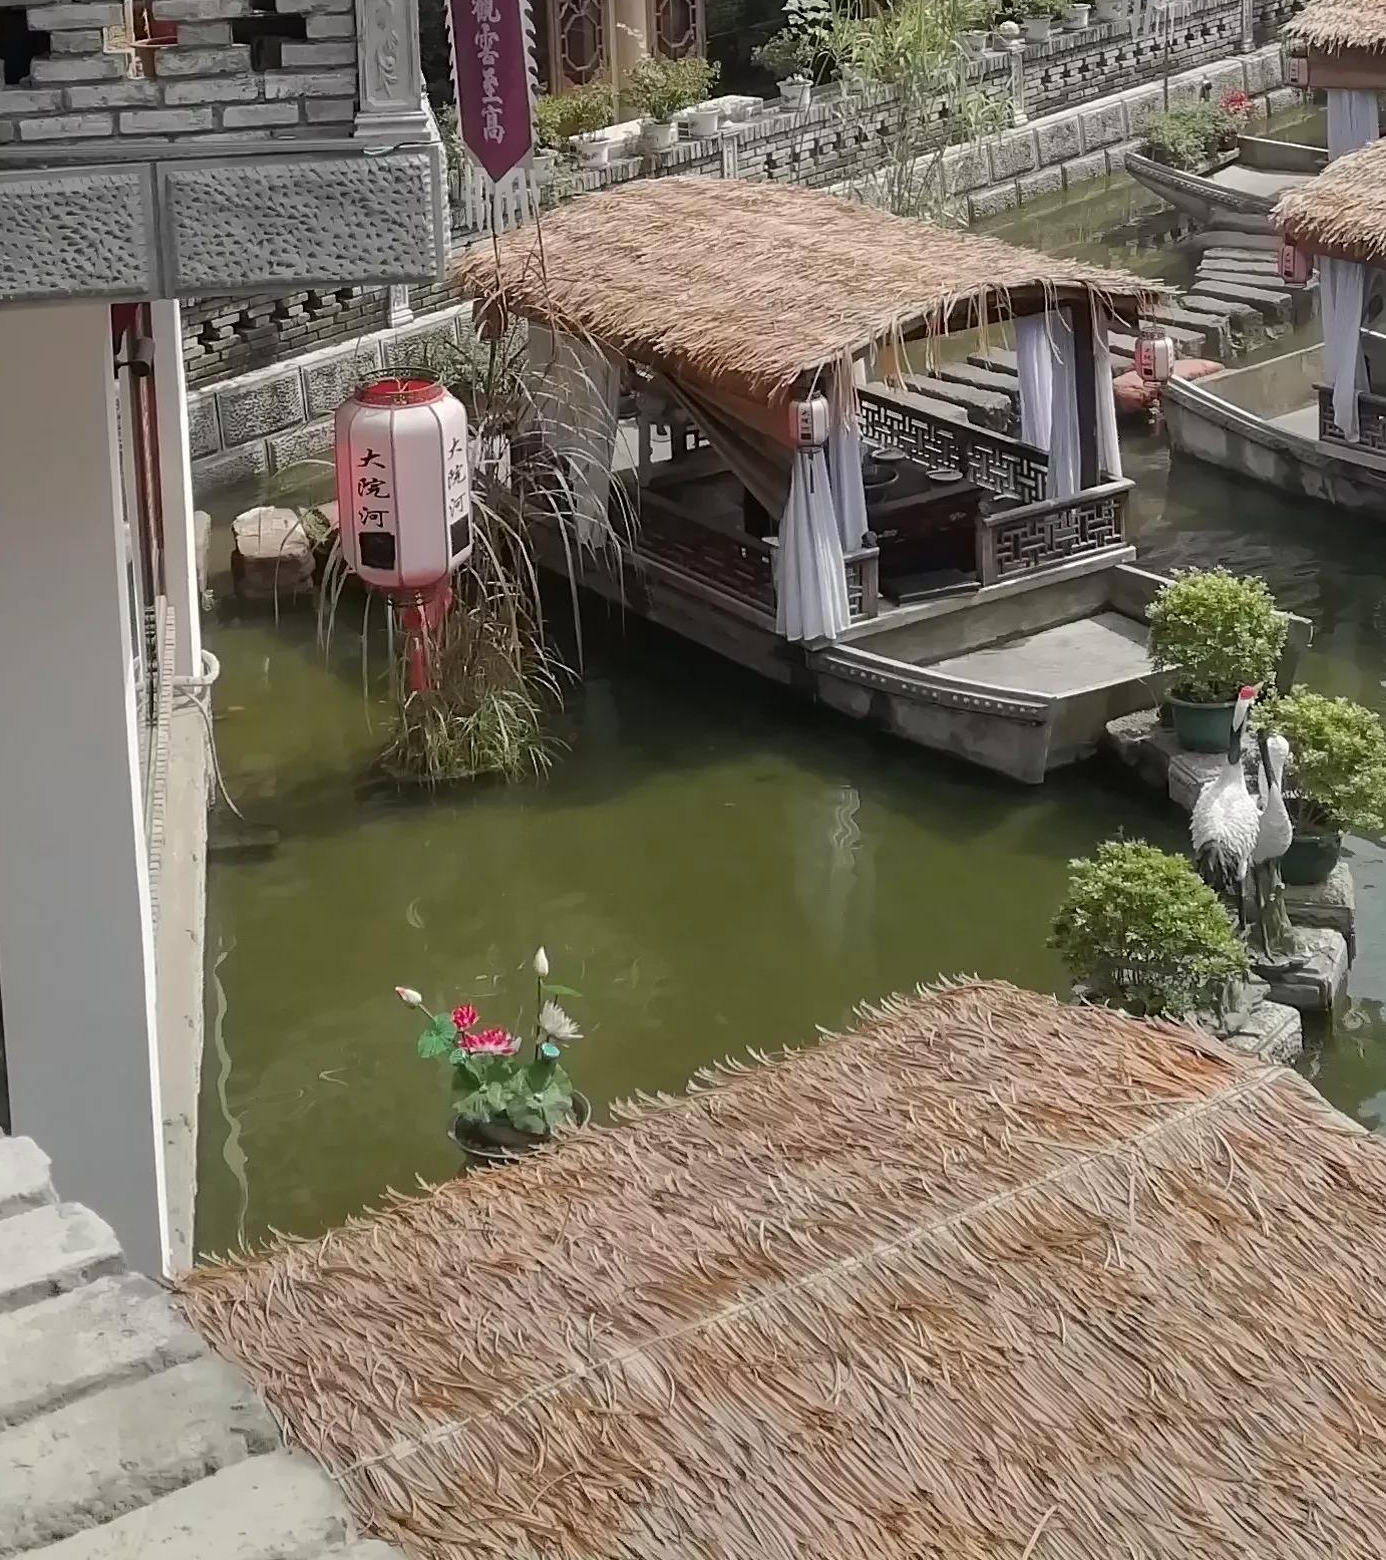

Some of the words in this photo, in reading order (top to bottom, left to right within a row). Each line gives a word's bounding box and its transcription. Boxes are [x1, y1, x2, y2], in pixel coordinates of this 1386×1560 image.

[357, 448, 390, 528] 大院河
[447, 437, 467, 518] 大院河
